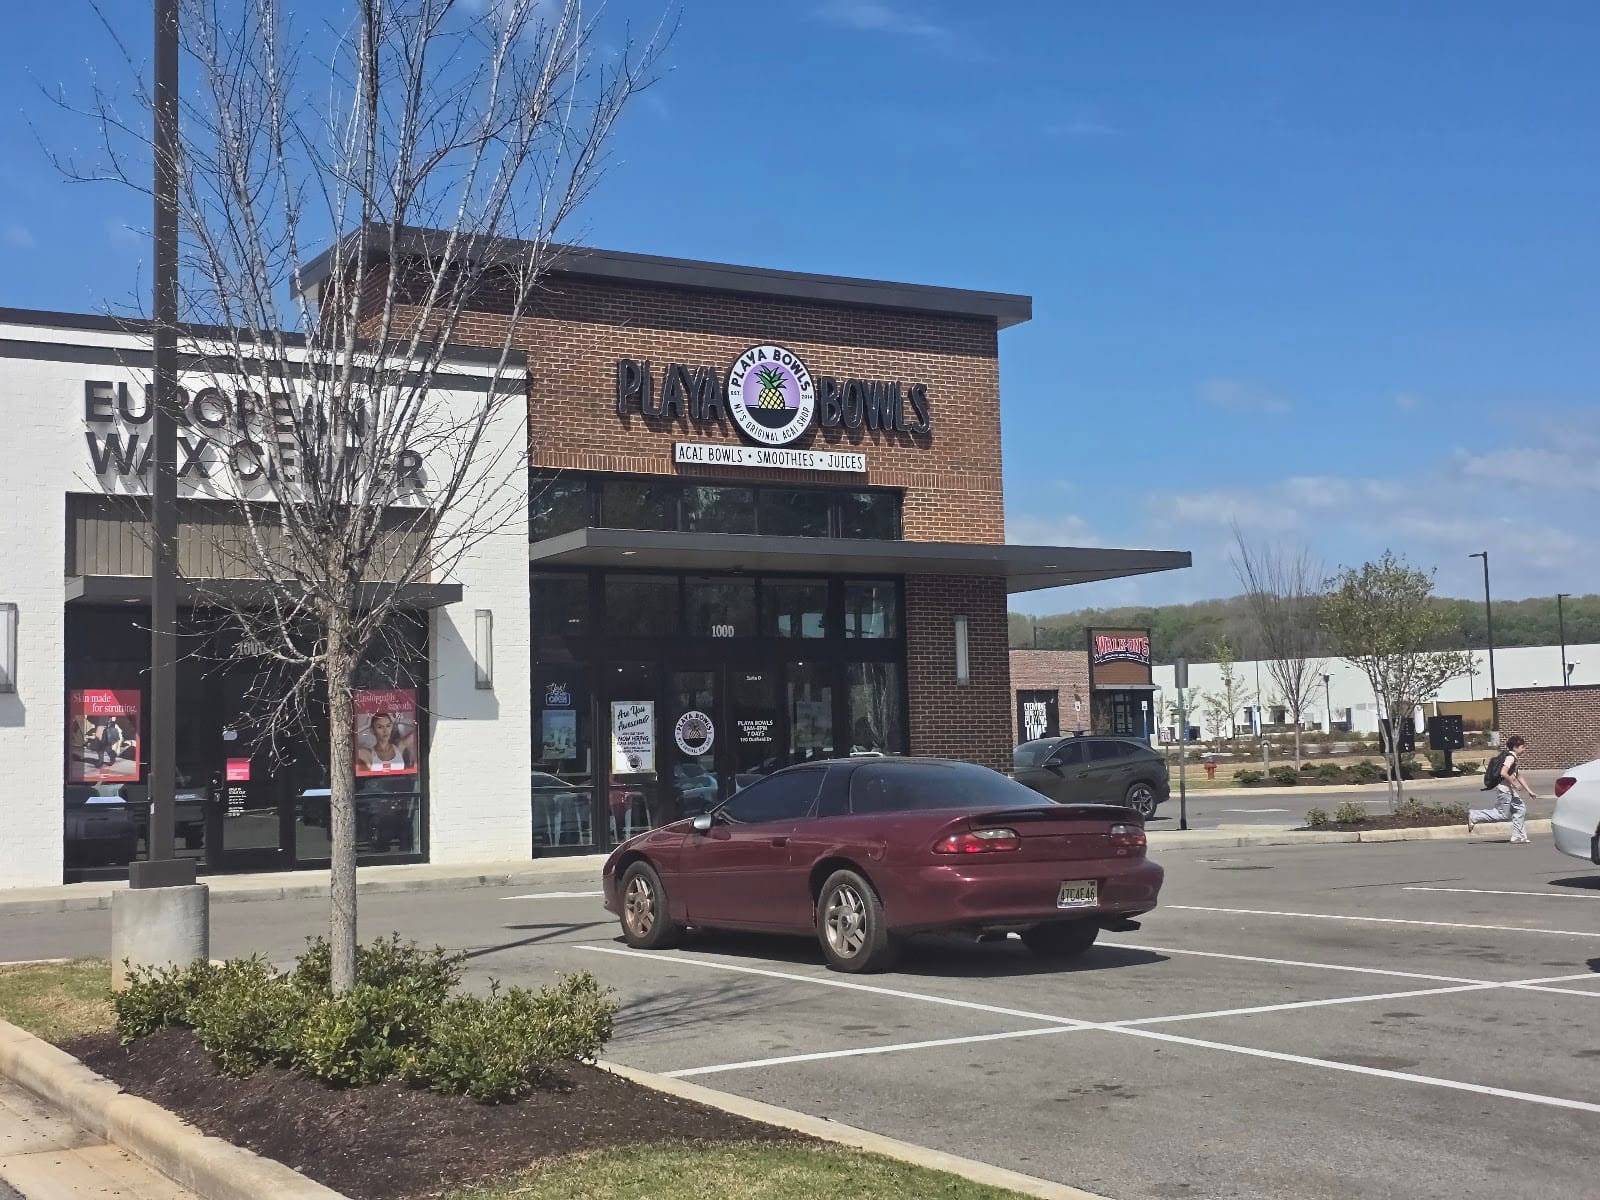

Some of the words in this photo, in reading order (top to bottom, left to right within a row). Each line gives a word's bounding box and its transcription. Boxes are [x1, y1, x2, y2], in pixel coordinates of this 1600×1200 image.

[731, 349, 767, 388] PLAYA
[773, 349, 811, 391] BOWLS
[616, 358, 725, 420] PLAYA
[817, 376, 931, 434] BOWLS
[733, 403, 747, 422] NJ'S
[745, 421, 780, 441] ORIGINAL
[782, 424, 799, 441] ACAI
[797, 406, 811, 427] SHOP
[678, 447, 703, 461] ACAI
[709, 448, 743, 463] BOWLS
[756, 451, 814, 467] SMOOTHIES
[827, 454, 863, 470] JUICES
[1095, 635, 1149, 657] WALK-ON'S
[91, 692, 111, 703] made
[92, 702, 104, 713] for
[617, 709, 630, 720] Are
[630, 705, 645, 717] You
[677, 713, 694, 731] PLAYA
[695, 713, 712, 731] BOWLS
